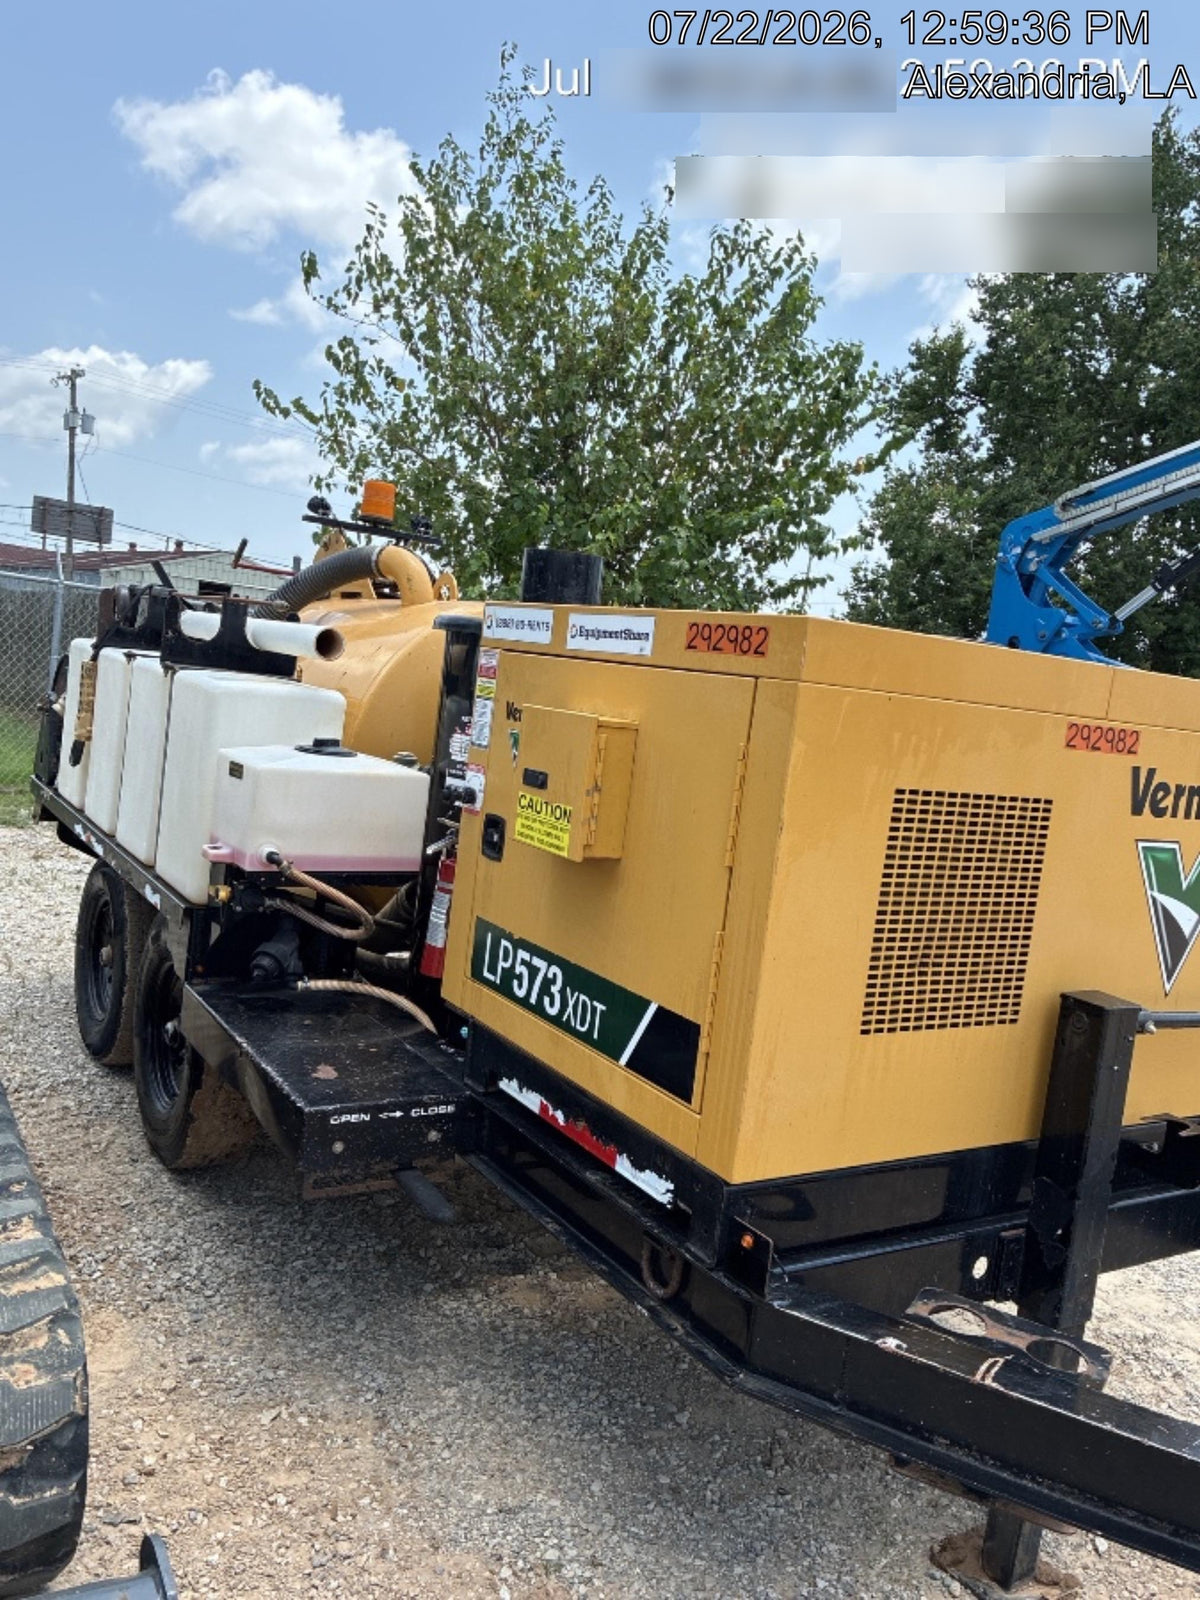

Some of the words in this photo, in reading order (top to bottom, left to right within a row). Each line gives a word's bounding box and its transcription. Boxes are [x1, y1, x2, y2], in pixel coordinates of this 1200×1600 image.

[686, 622, 769, 657] 292982
[1065, 722, 1140, 755] 292982
[518, 793, 572, 825] CAUTION
[329, 1112, 371, 1125] OPEN
[410, 1104, 456, 1117] CLOSE
